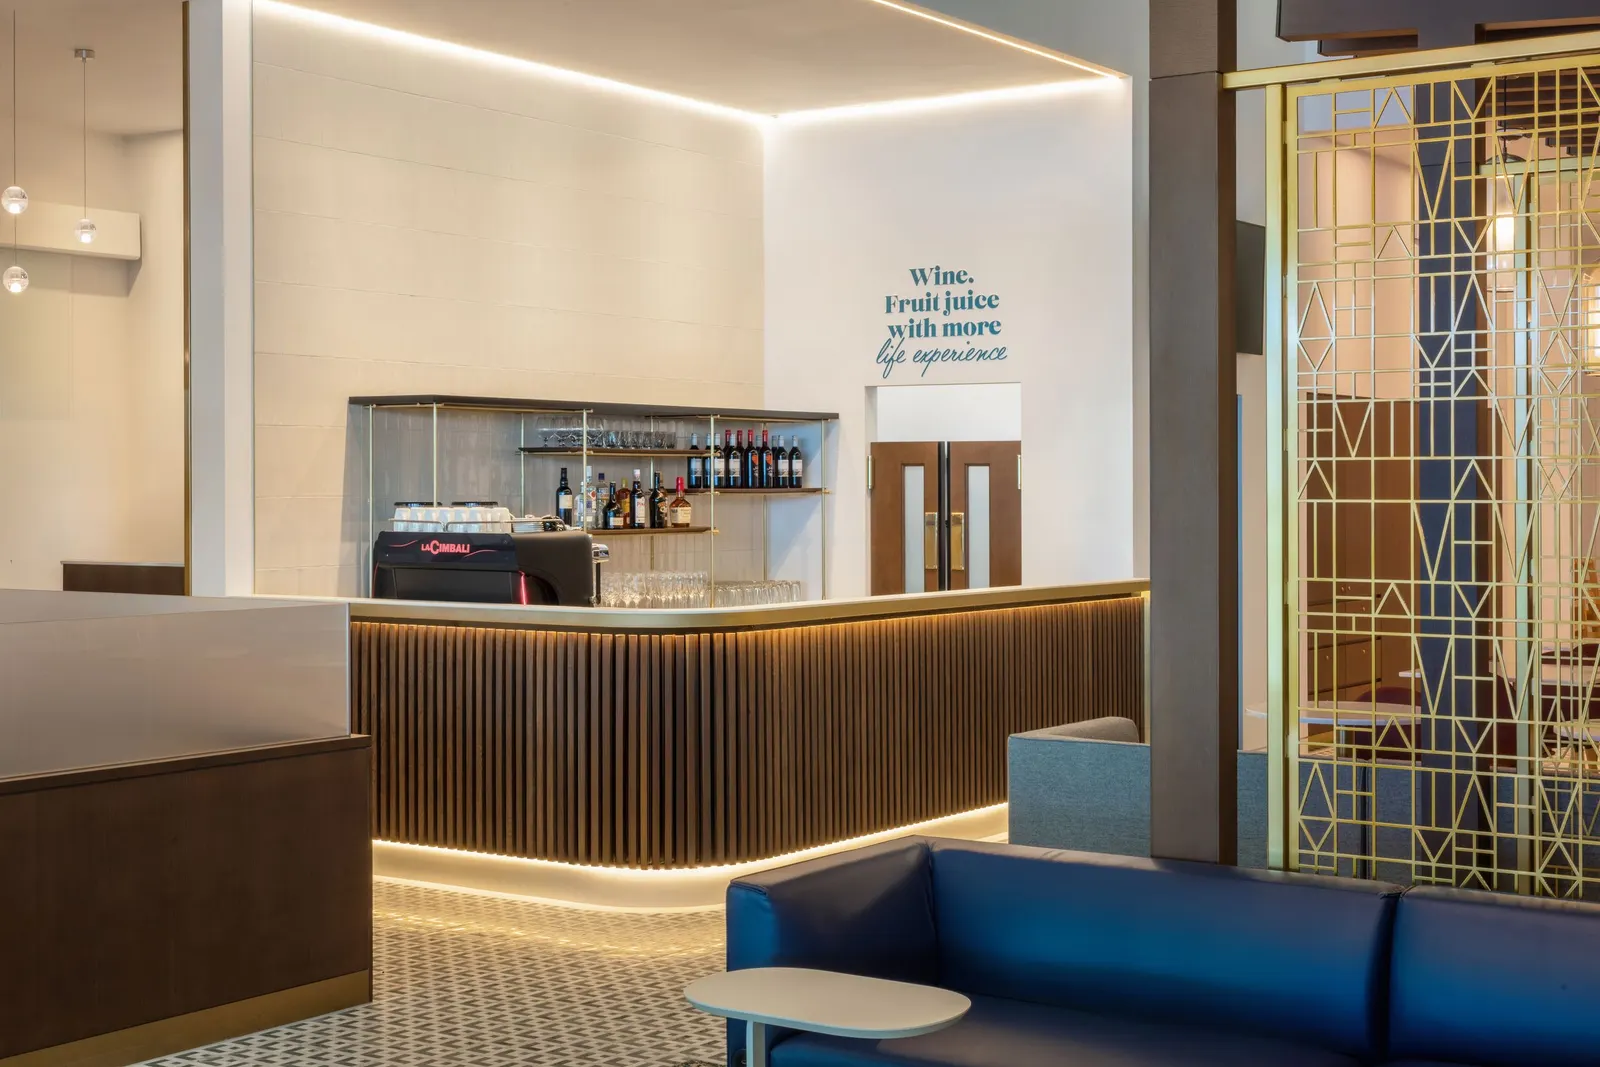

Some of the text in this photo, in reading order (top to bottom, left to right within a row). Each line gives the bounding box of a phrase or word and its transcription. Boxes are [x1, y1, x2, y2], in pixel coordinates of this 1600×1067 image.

[909, 265, 974, 286] Wine.
[885, 289, 1000, 316] Fruit juice
[887, 318, 1002, 339] with more
[876, 337, 1008, 379] life experience
